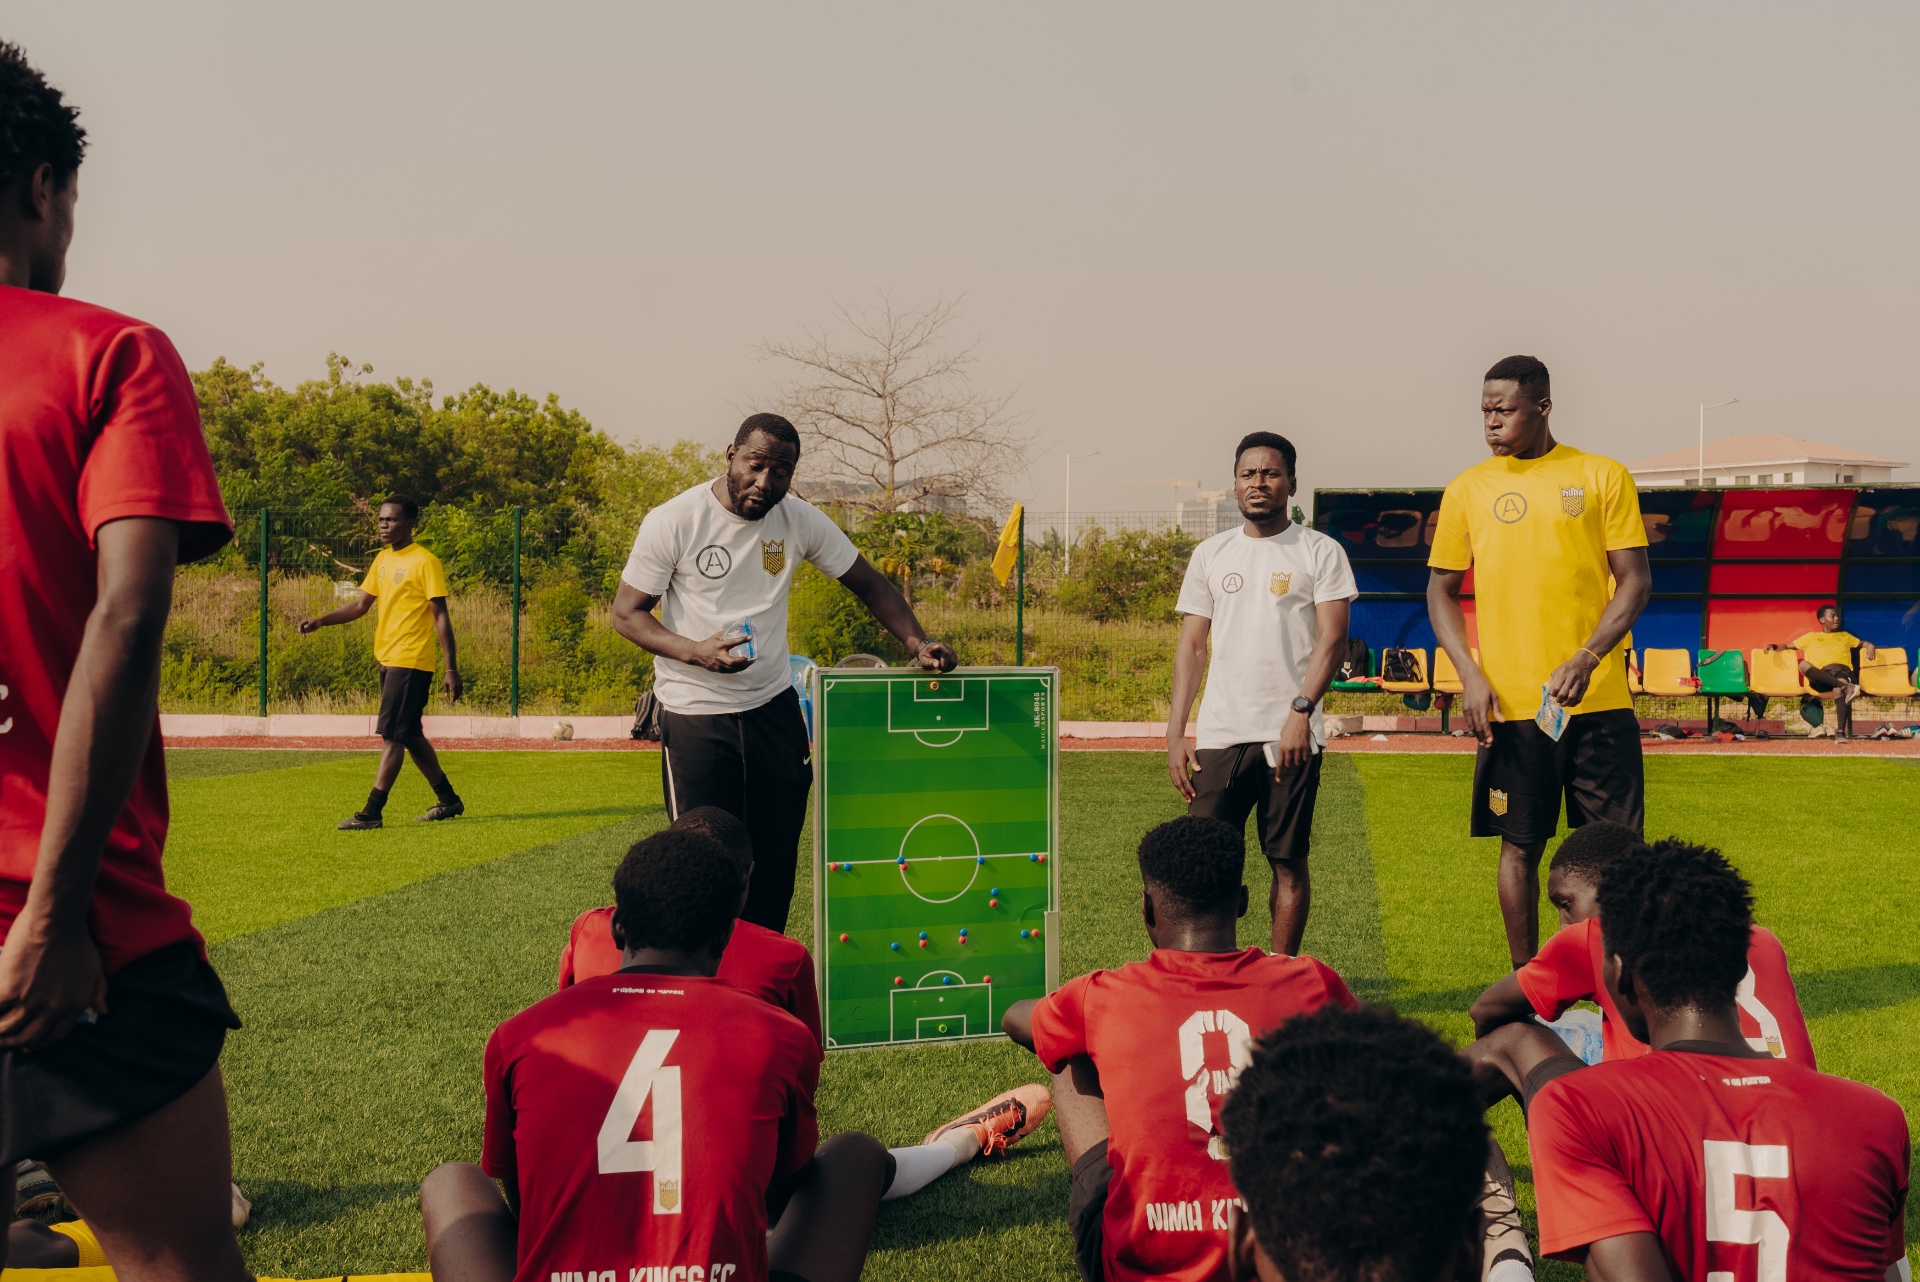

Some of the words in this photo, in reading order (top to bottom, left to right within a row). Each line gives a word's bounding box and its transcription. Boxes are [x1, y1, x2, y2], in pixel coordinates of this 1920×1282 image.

[1562, 487, 1584, 497] NIMA
[764, 543, 783, 553] NIMA
[597, 1028, 682, 1215] 4
[1146, 1200, 1203, 1232] NIMA
[1703, 1139, 1791, 1282] 5
